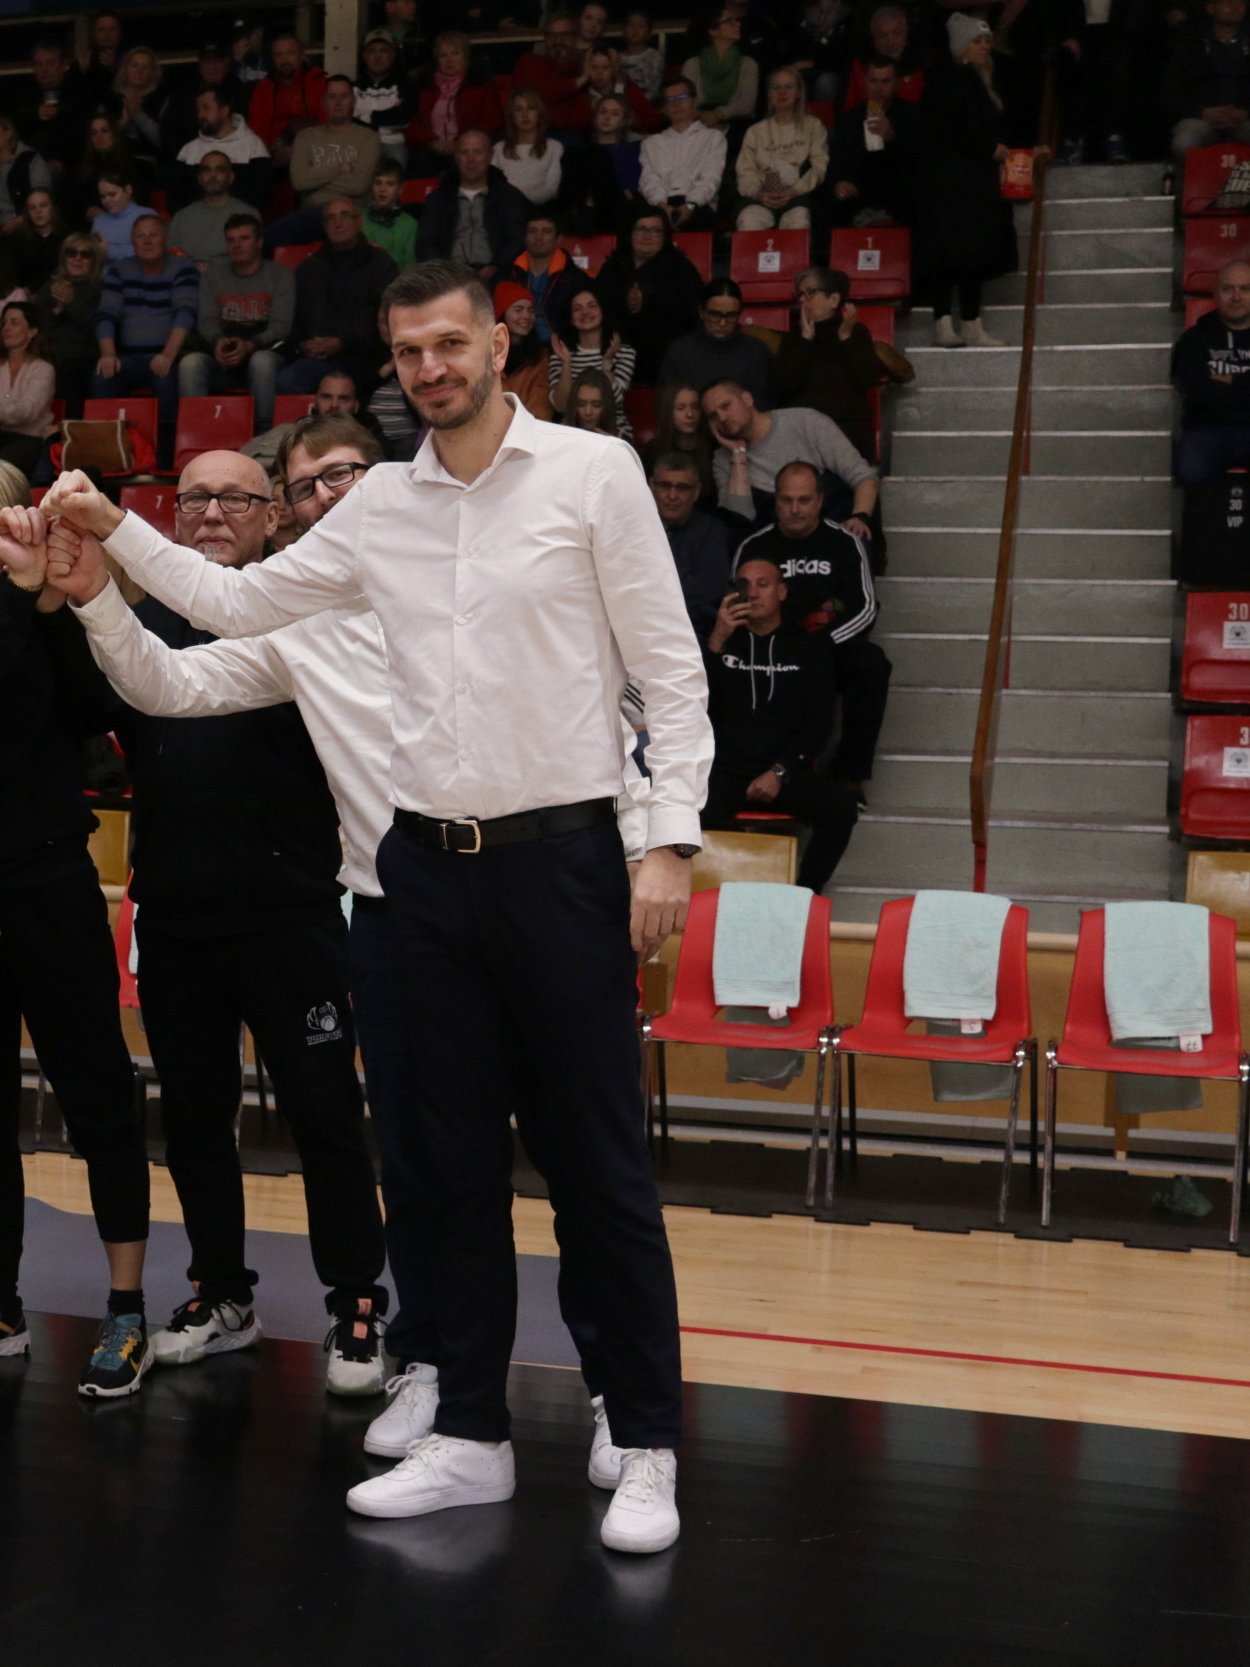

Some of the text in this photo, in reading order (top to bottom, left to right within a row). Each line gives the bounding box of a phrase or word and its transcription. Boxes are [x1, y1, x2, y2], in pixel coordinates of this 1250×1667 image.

[1220, 223, 1237, 238] 30
[766, 238, 775, 252] 2
[865, 236, 873, 249] 1
[214, 405, 222, 419] 7
[1229, 499, 1243, 511] 30
[1227, 516, 1244, 528] VIP
[779, 557, 832, 579] didas
[1229, 603, 1249, 620] 30
[722, 654, 800, 677] Champion
